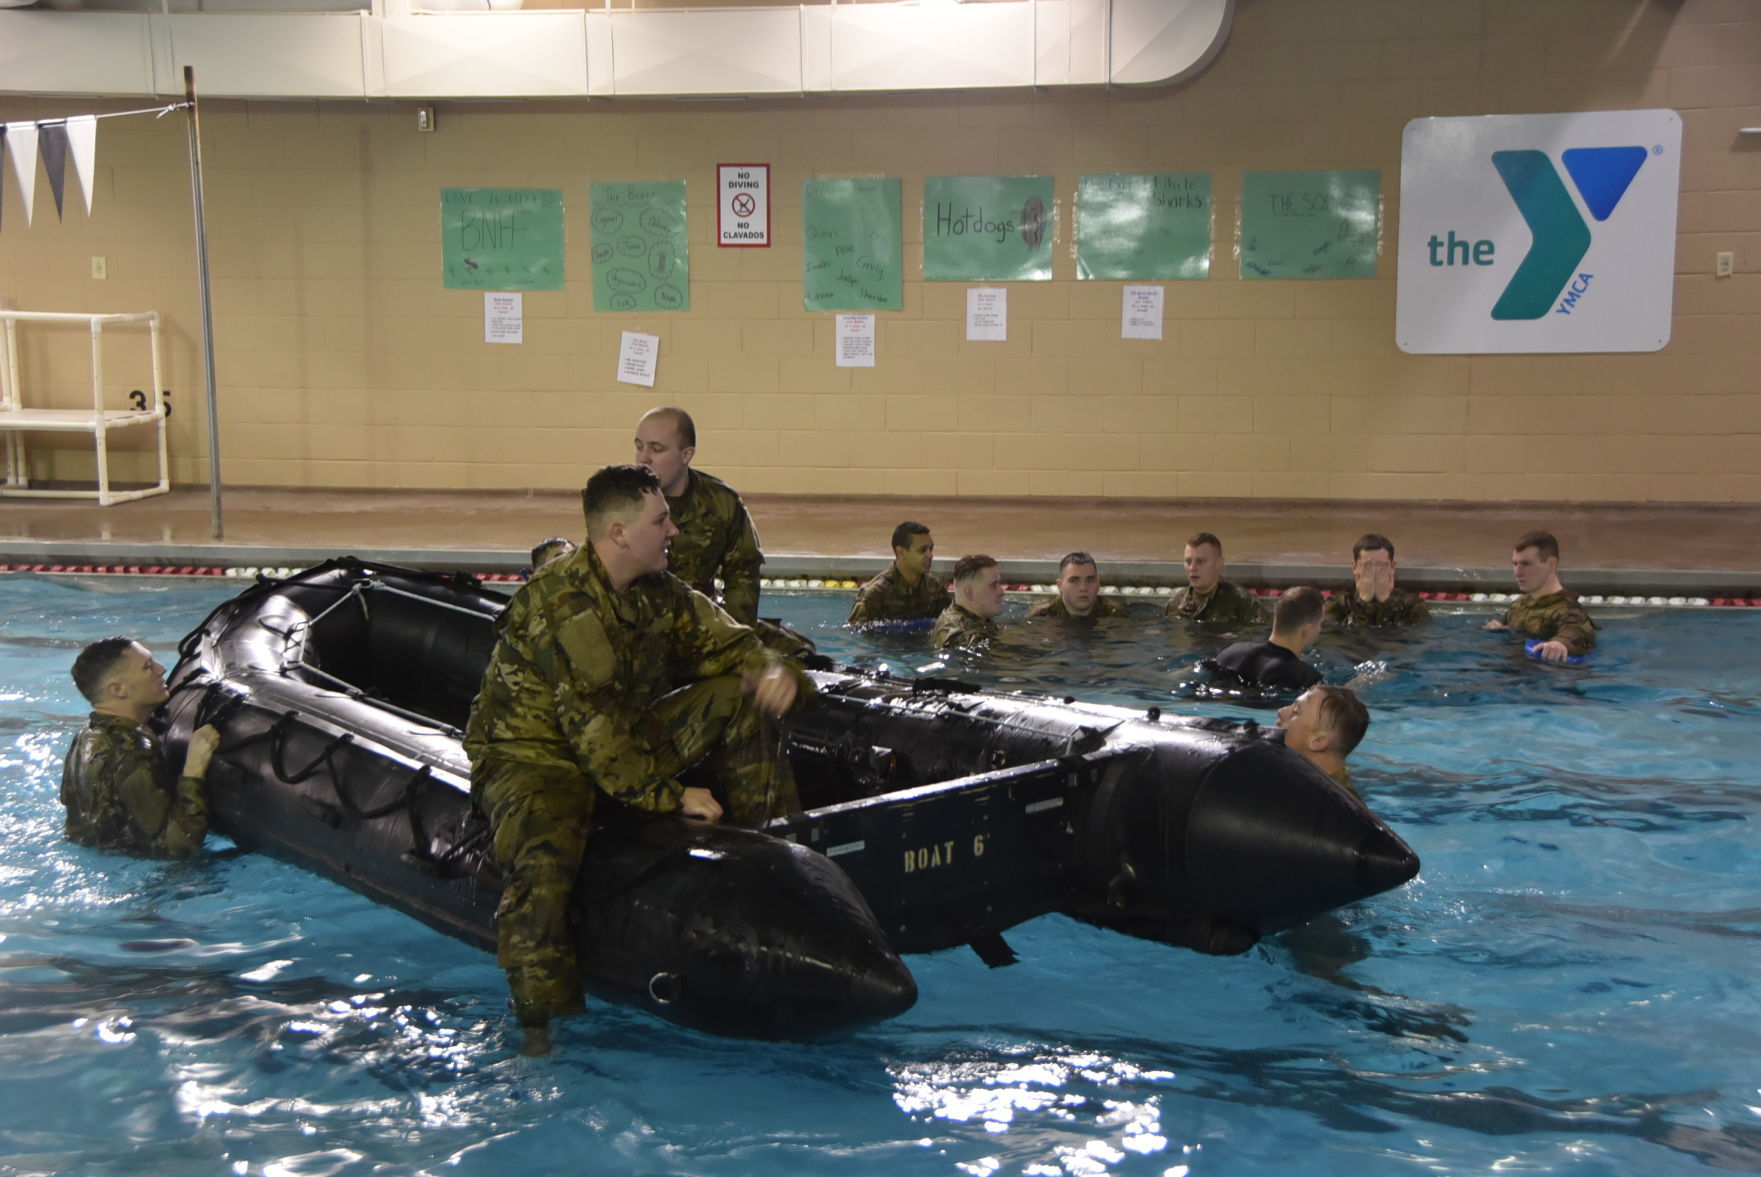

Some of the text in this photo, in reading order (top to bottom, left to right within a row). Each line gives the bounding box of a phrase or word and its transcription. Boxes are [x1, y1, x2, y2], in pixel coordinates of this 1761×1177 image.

[728, 181, 760, 189] DIVING
[737, 171, 750, 180] NO
[737, 221, 750, 230] NO
[936, 200, 1016, 244] Hotdogs
[723, 231, 765, 239] CLAVADOS
[1427, 230, 1495, 267] the
[1555, 272, 1594, 316] YMCA
[903, 834, 985, 873] BOAT 6
